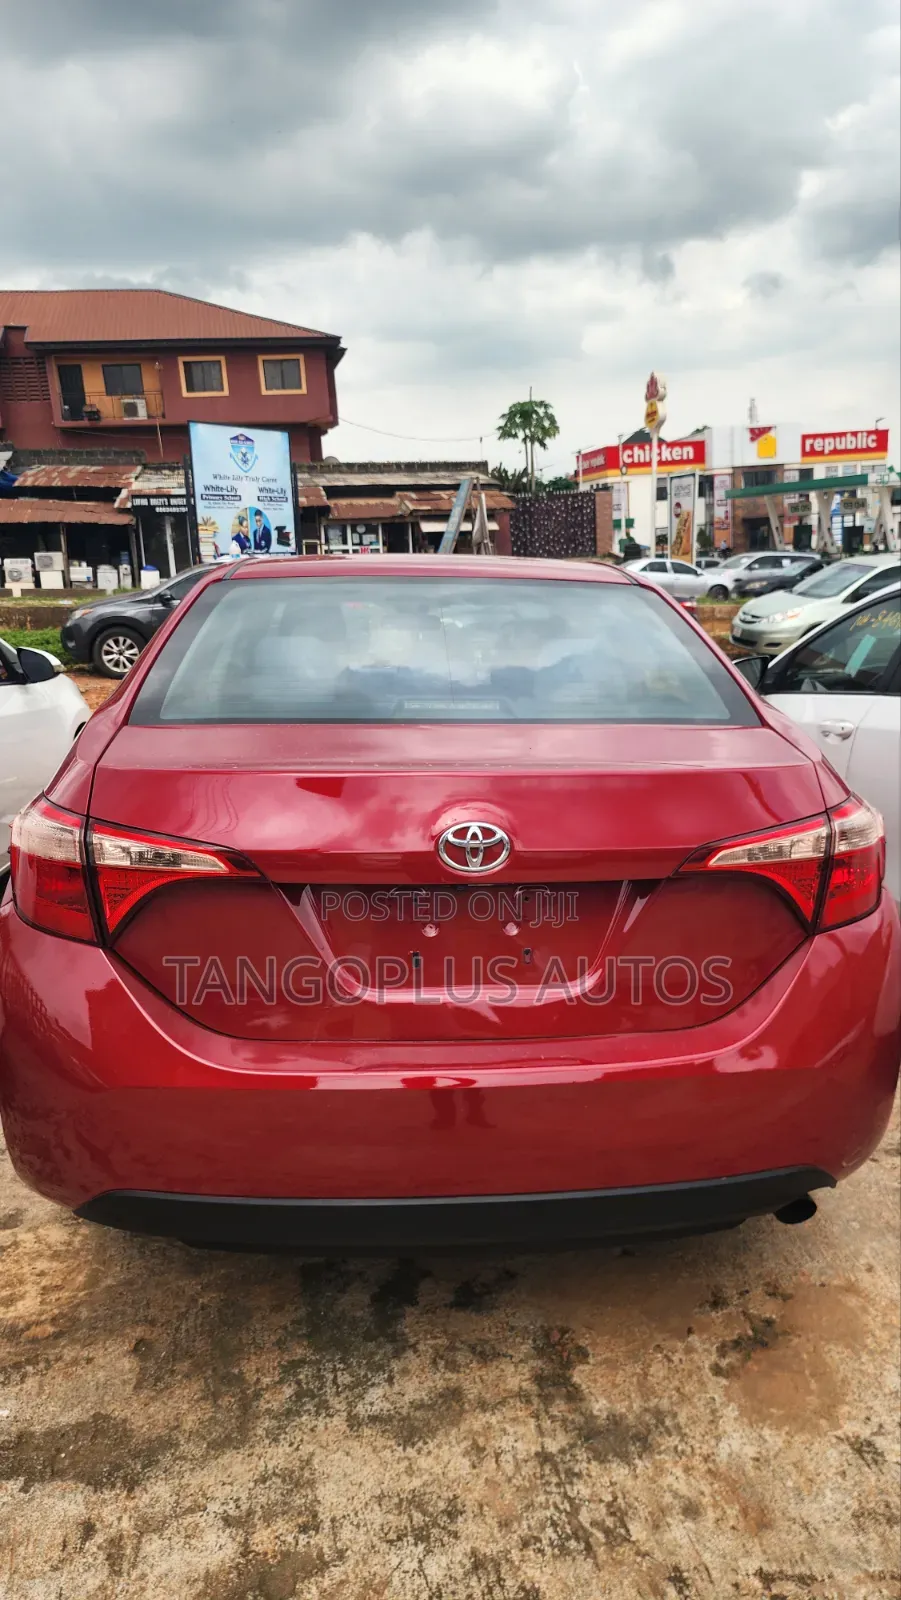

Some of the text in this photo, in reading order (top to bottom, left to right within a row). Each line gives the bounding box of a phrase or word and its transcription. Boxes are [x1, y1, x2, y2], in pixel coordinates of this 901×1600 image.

[805, 432, 878, 454] republic
[212, 473, 230, 481] White
[203, 484, 239, 494] White-Lily
[258, 486, 287, 496] White-Lily
